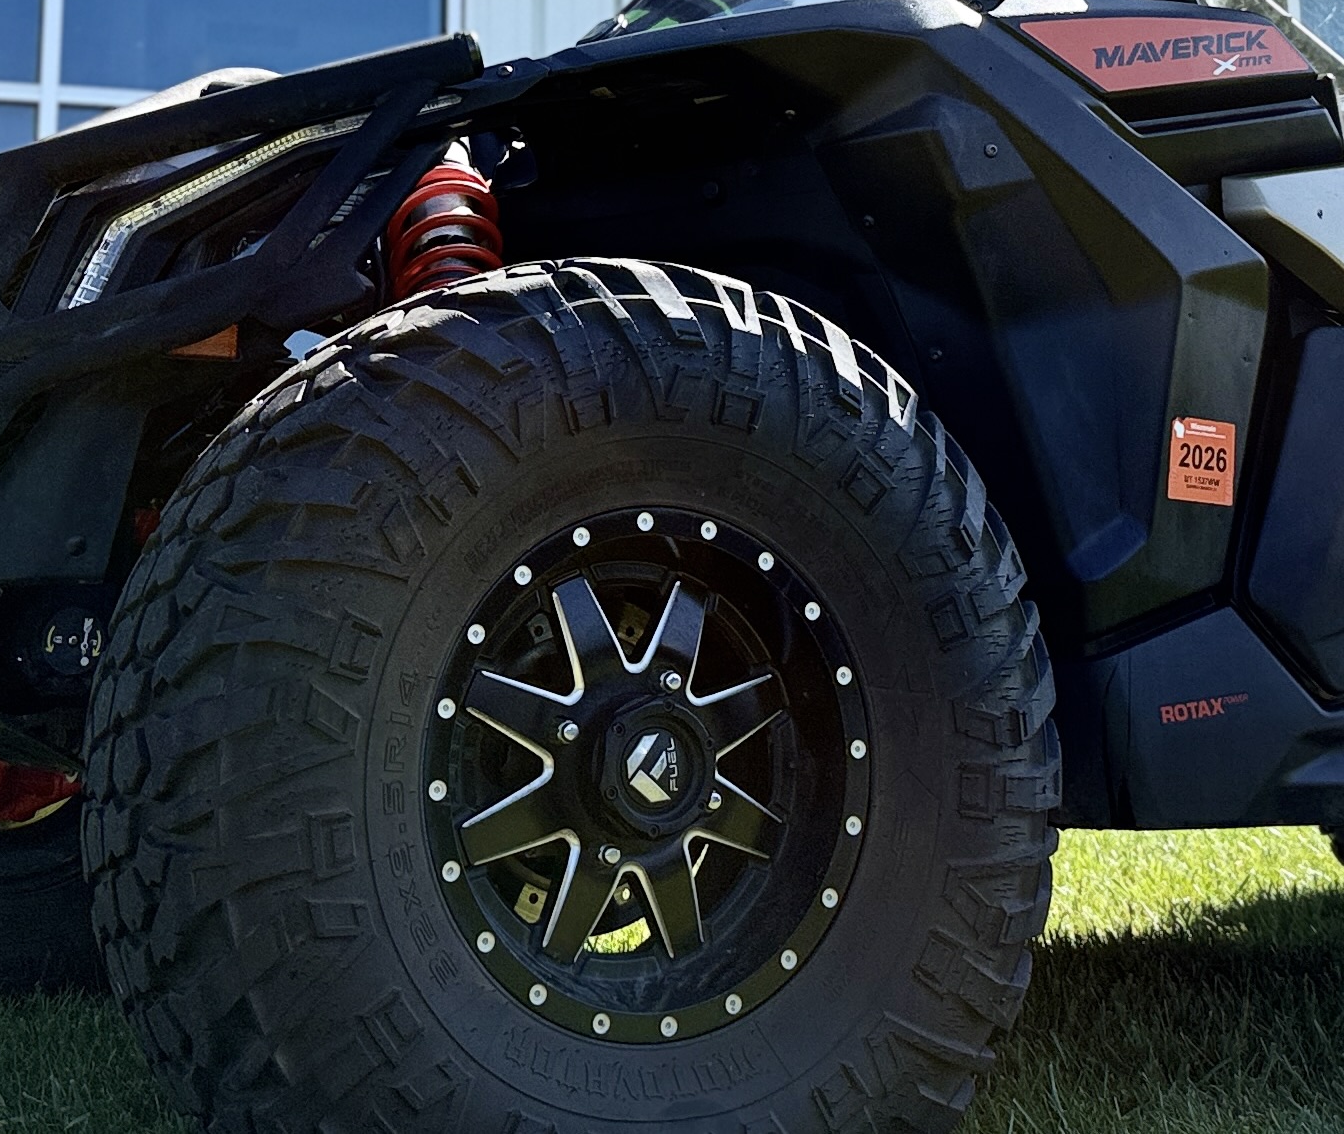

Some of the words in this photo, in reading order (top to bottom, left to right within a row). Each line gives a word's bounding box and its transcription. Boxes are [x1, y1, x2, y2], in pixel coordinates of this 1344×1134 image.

[1092, 28, 1269, 70] MAVERICK
[1178, 442, 1228, 474] 2026
[1159, 697, 1226, 725] ROTAX
[666, 735, 680, 793] FUEL
